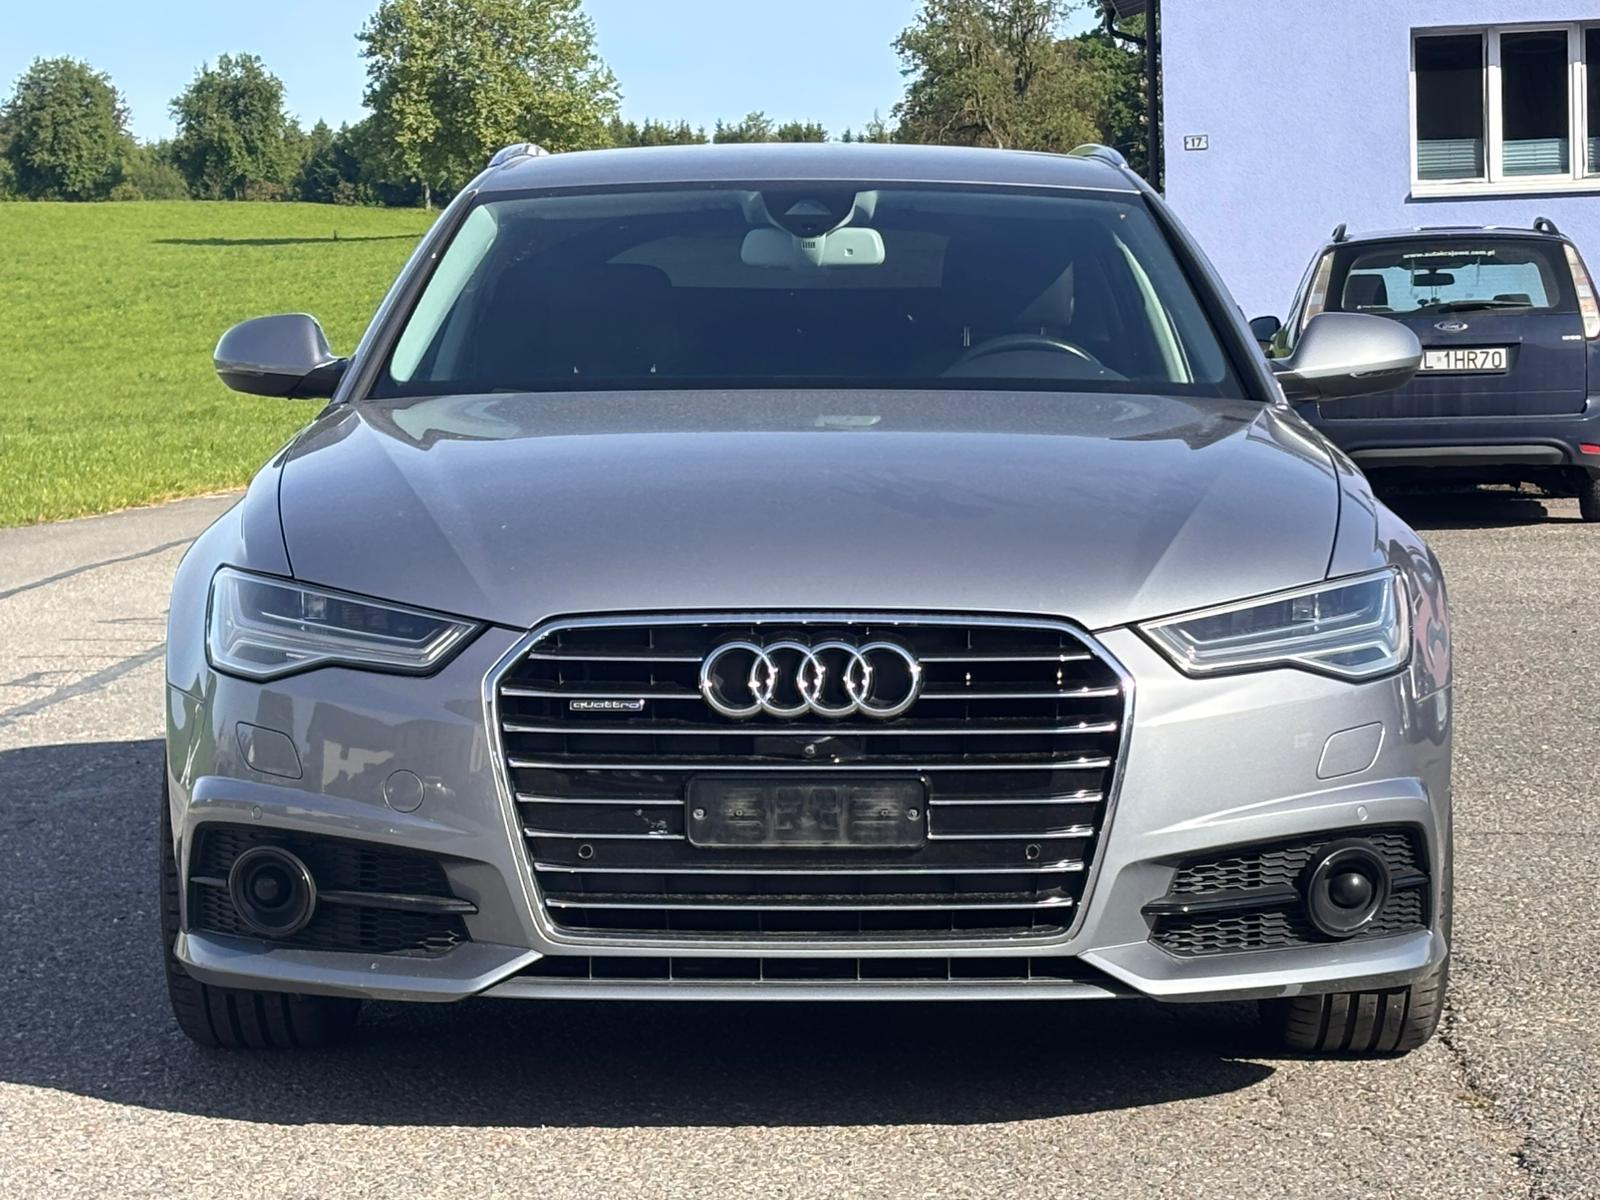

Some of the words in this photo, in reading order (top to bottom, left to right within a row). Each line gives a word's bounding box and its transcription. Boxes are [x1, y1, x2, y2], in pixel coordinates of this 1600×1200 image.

[1191, 137, 1202, 148] 17
[1444, 350, 1502, 369] 1HR70
[573, 701, 640, 709] quattro
